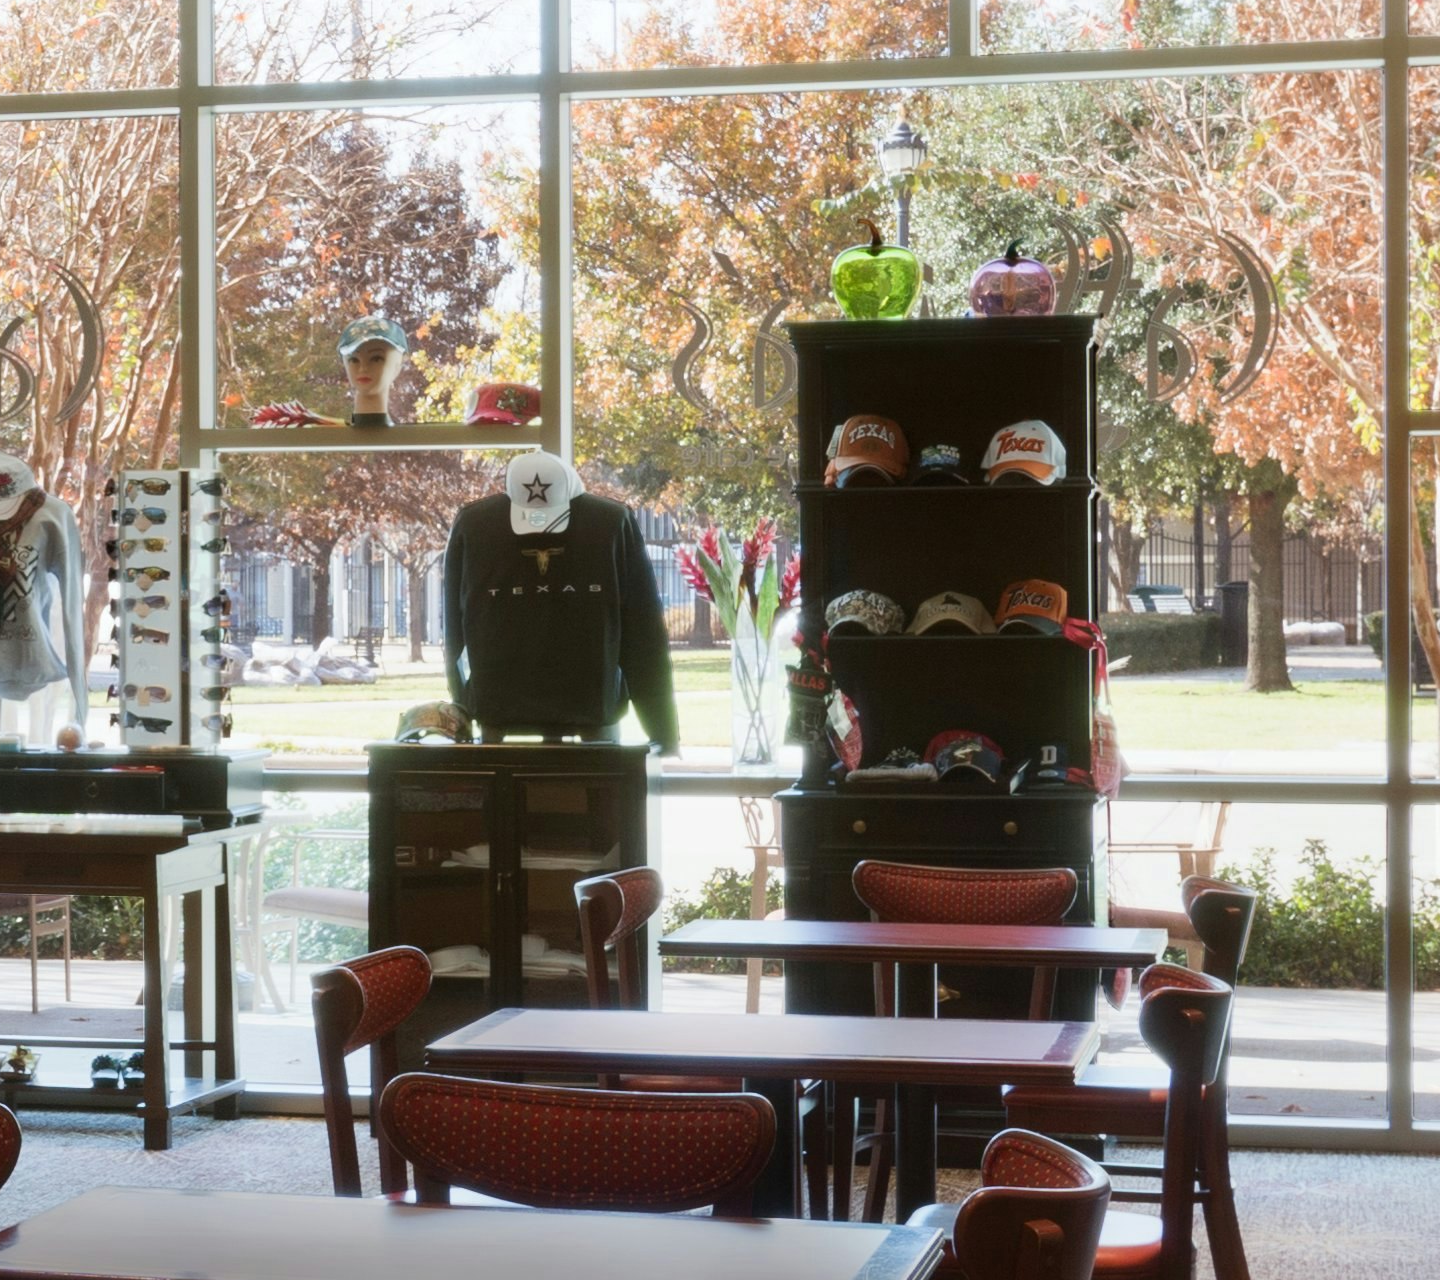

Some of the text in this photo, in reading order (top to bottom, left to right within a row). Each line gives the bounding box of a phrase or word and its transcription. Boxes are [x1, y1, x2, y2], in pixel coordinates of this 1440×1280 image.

[848, 423, 896, 449] TEXAS
[996, 431, 1046, 460] Texas
[488, 584, 602, 597] TEXAS
[1007, 588, 1055, 611] Texas
[1041, 746, 1057, 765] D
